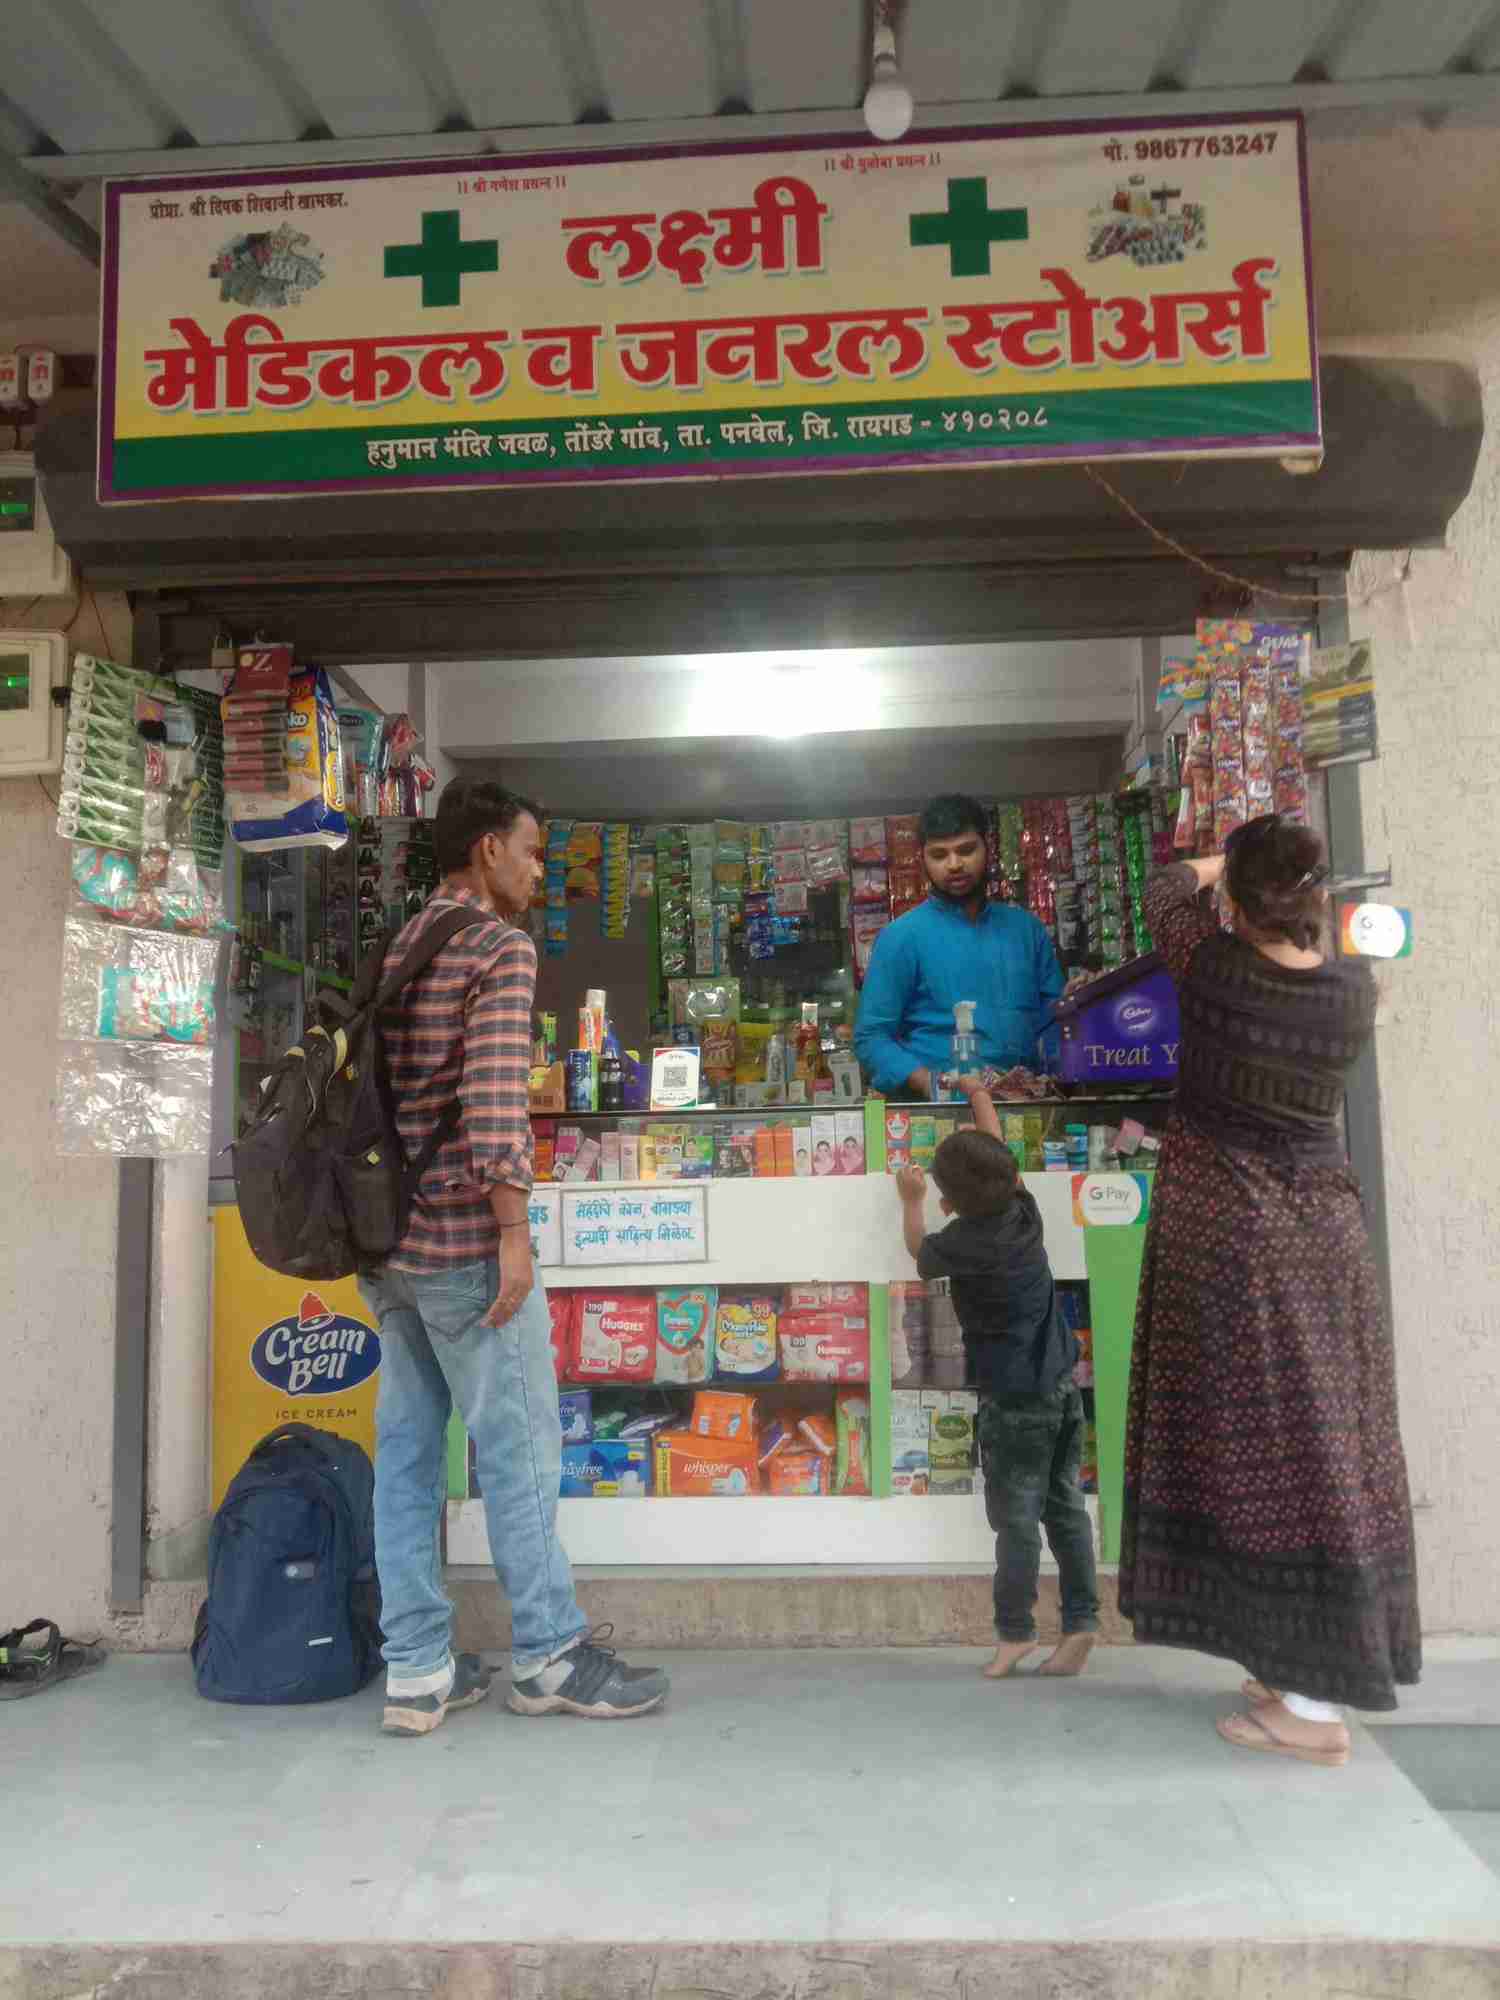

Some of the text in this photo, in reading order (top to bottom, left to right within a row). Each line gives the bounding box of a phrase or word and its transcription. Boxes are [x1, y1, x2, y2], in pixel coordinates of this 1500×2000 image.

[1134, 131, 1279, 161] 9867763247
[560, 175, 829, 287] लक्ष्मी
[142, 257, 1278, 413] मेडिकल व जनरल स्टोअर्स
[366, 437, 437, 469] हनुमान
[443, 427, 492, 459] मंदिर
[497, 431, 557, 458] जवळ,
[563, 421, 617, 453] तोंडरे
[619, 420, 670, 453] गांव,
[676, 423, 713, 448] ता.
[719, 413, 794, 446] पनवेल,
[801, 411, 839, 441] जि.
[847, 413, 913, 438] रायगड
[941, 406, 1049, 435] ४१०२०८
[1083, 1044, 1153, 1067] Treat
[264, 1326, 366, 1366] Cream
[287, 1352, 348, 1392] Bell
[275, 1407, 358, 1420] ICE CREAM
